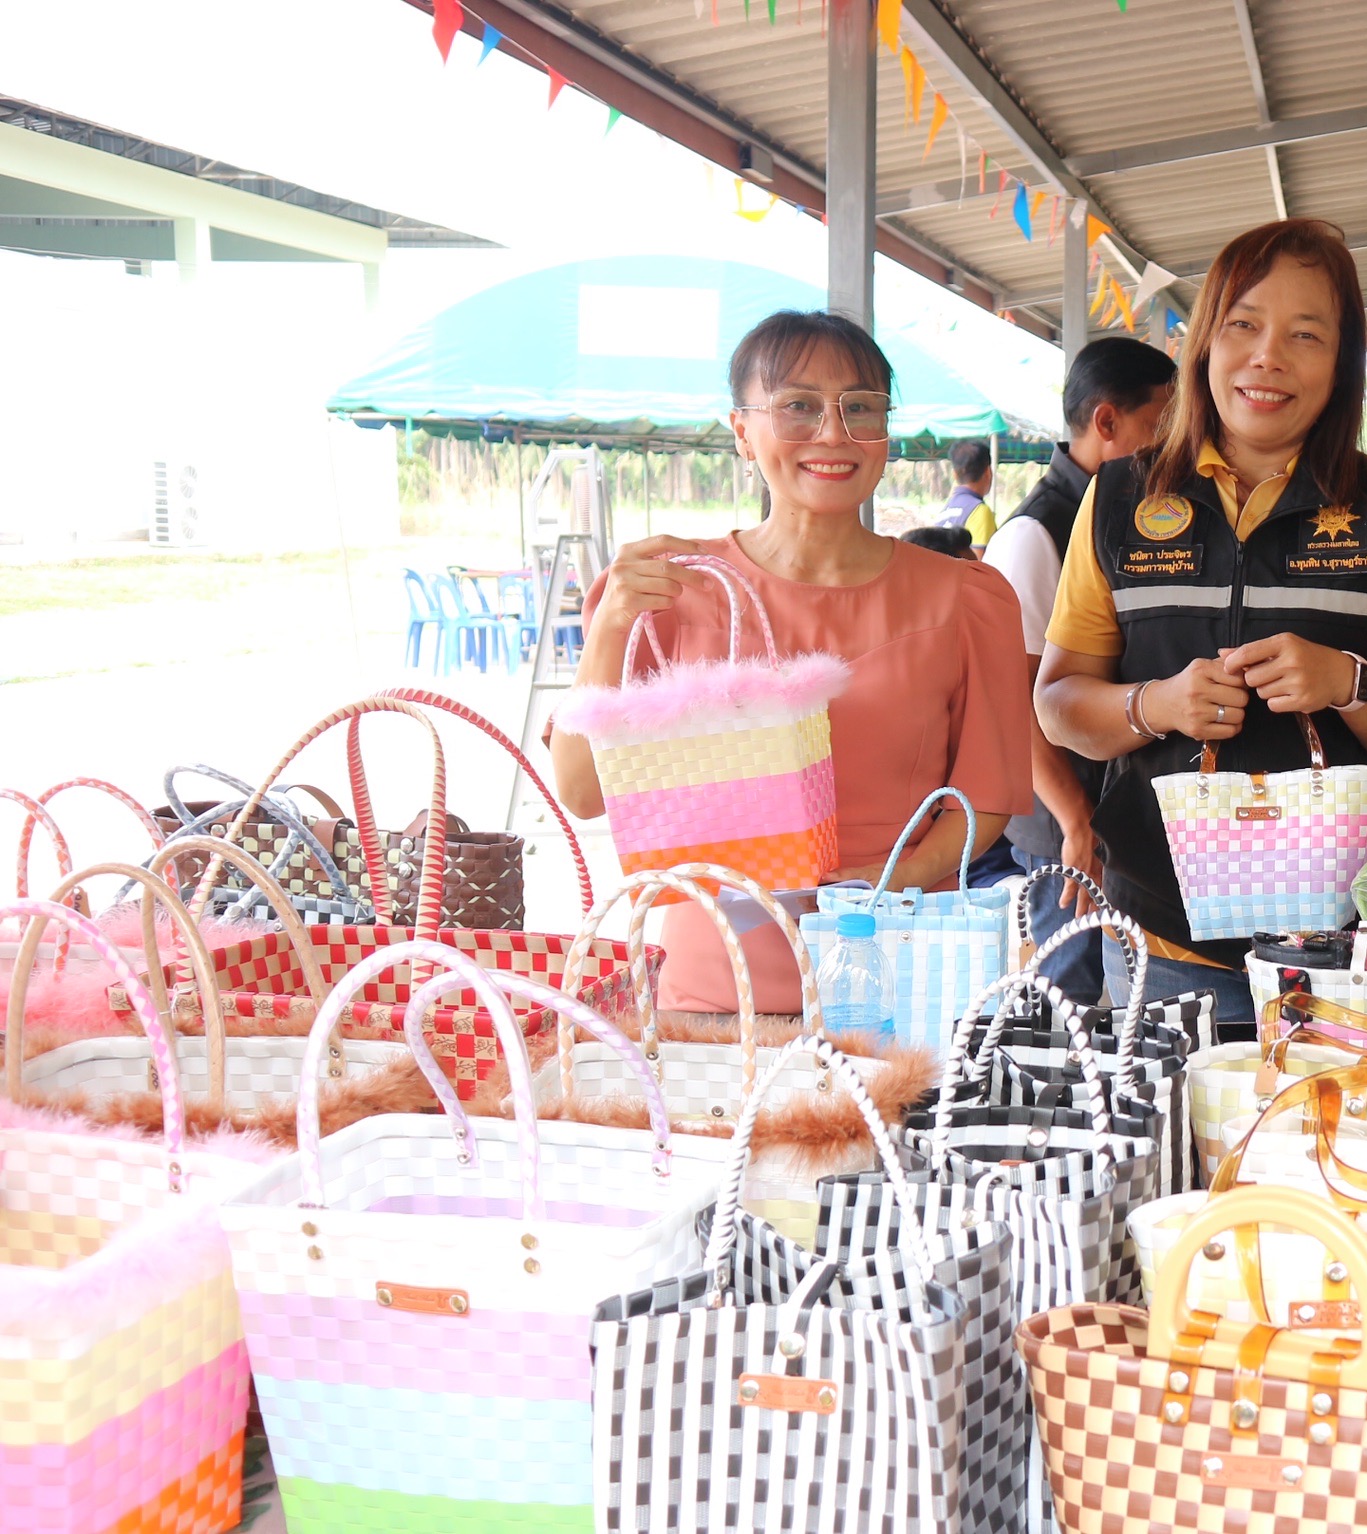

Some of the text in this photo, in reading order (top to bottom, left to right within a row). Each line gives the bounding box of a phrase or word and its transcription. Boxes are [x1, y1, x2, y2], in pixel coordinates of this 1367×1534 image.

[1124, 560, 1194, 574] กรรมการหมู่บ้าน
